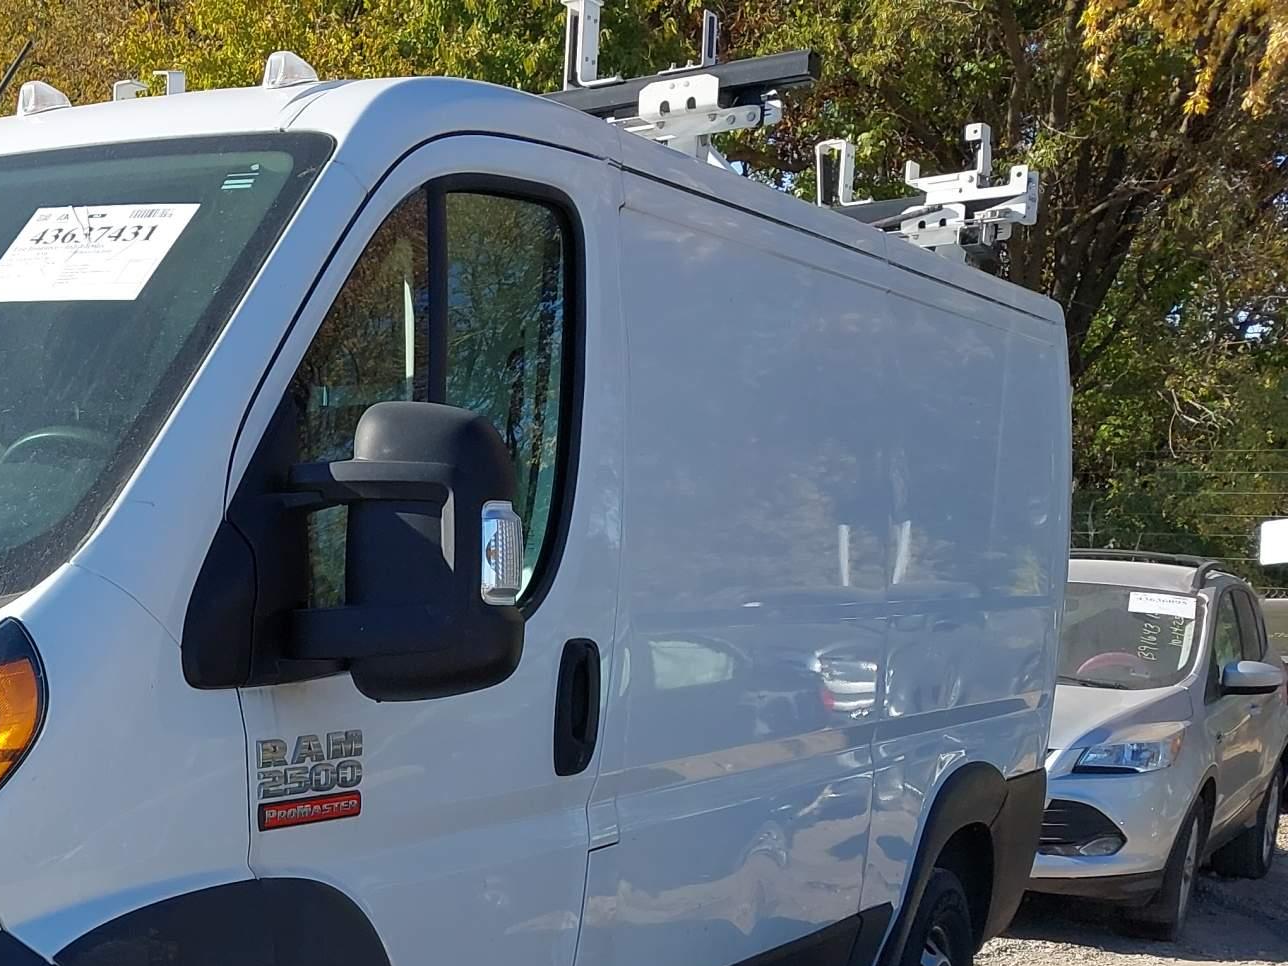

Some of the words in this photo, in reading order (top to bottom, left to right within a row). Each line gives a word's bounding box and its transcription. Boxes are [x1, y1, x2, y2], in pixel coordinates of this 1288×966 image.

[29, 224, 159, 245] 43637431
[256, 729, 363, 768] RAM
[256, 760, 364, 800] 2500
